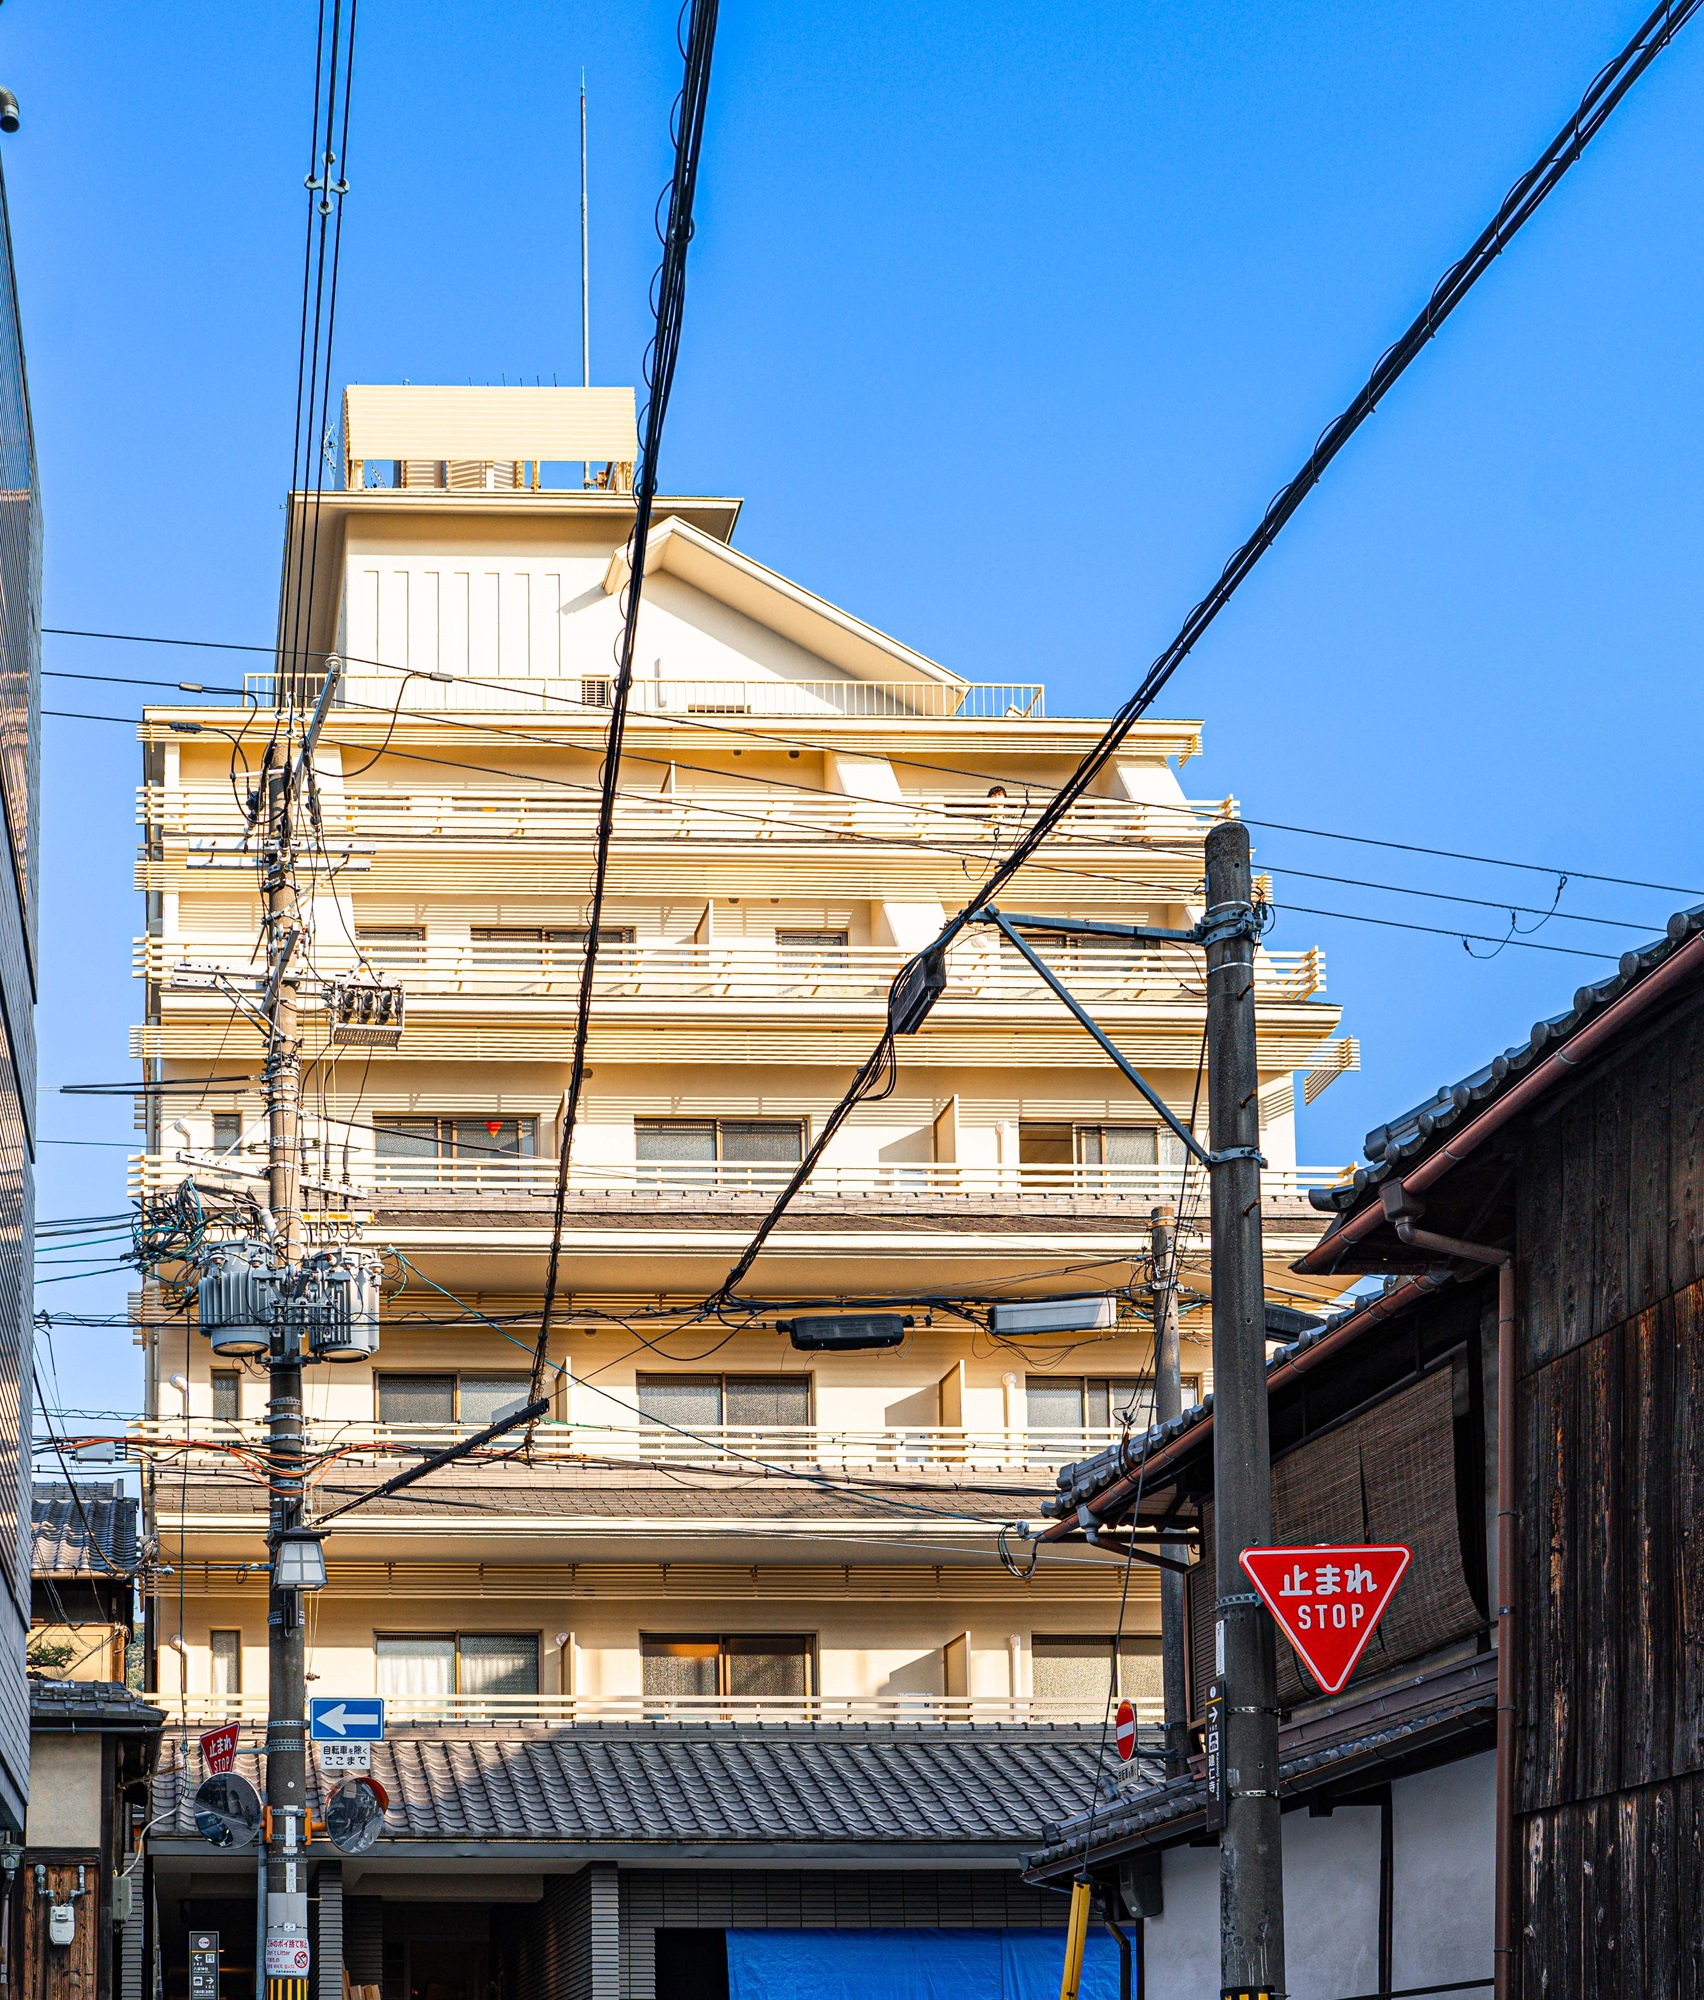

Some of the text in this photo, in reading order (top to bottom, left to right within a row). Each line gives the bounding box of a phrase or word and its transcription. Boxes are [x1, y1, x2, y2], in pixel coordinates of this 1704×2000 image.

[231, 1252, 249, 1266] 75
[1278, 1563, 1378, 1596] 止まれ
[1297, 1603, 1364, 1630] STOP
[209, 1734, 233, 1758] 止まれ
[323, 1745, 368, 1755] 自転車を除く
[213, 1756, 230, 1773] STOP
[324, 1756, 367, 1766] ここまで
